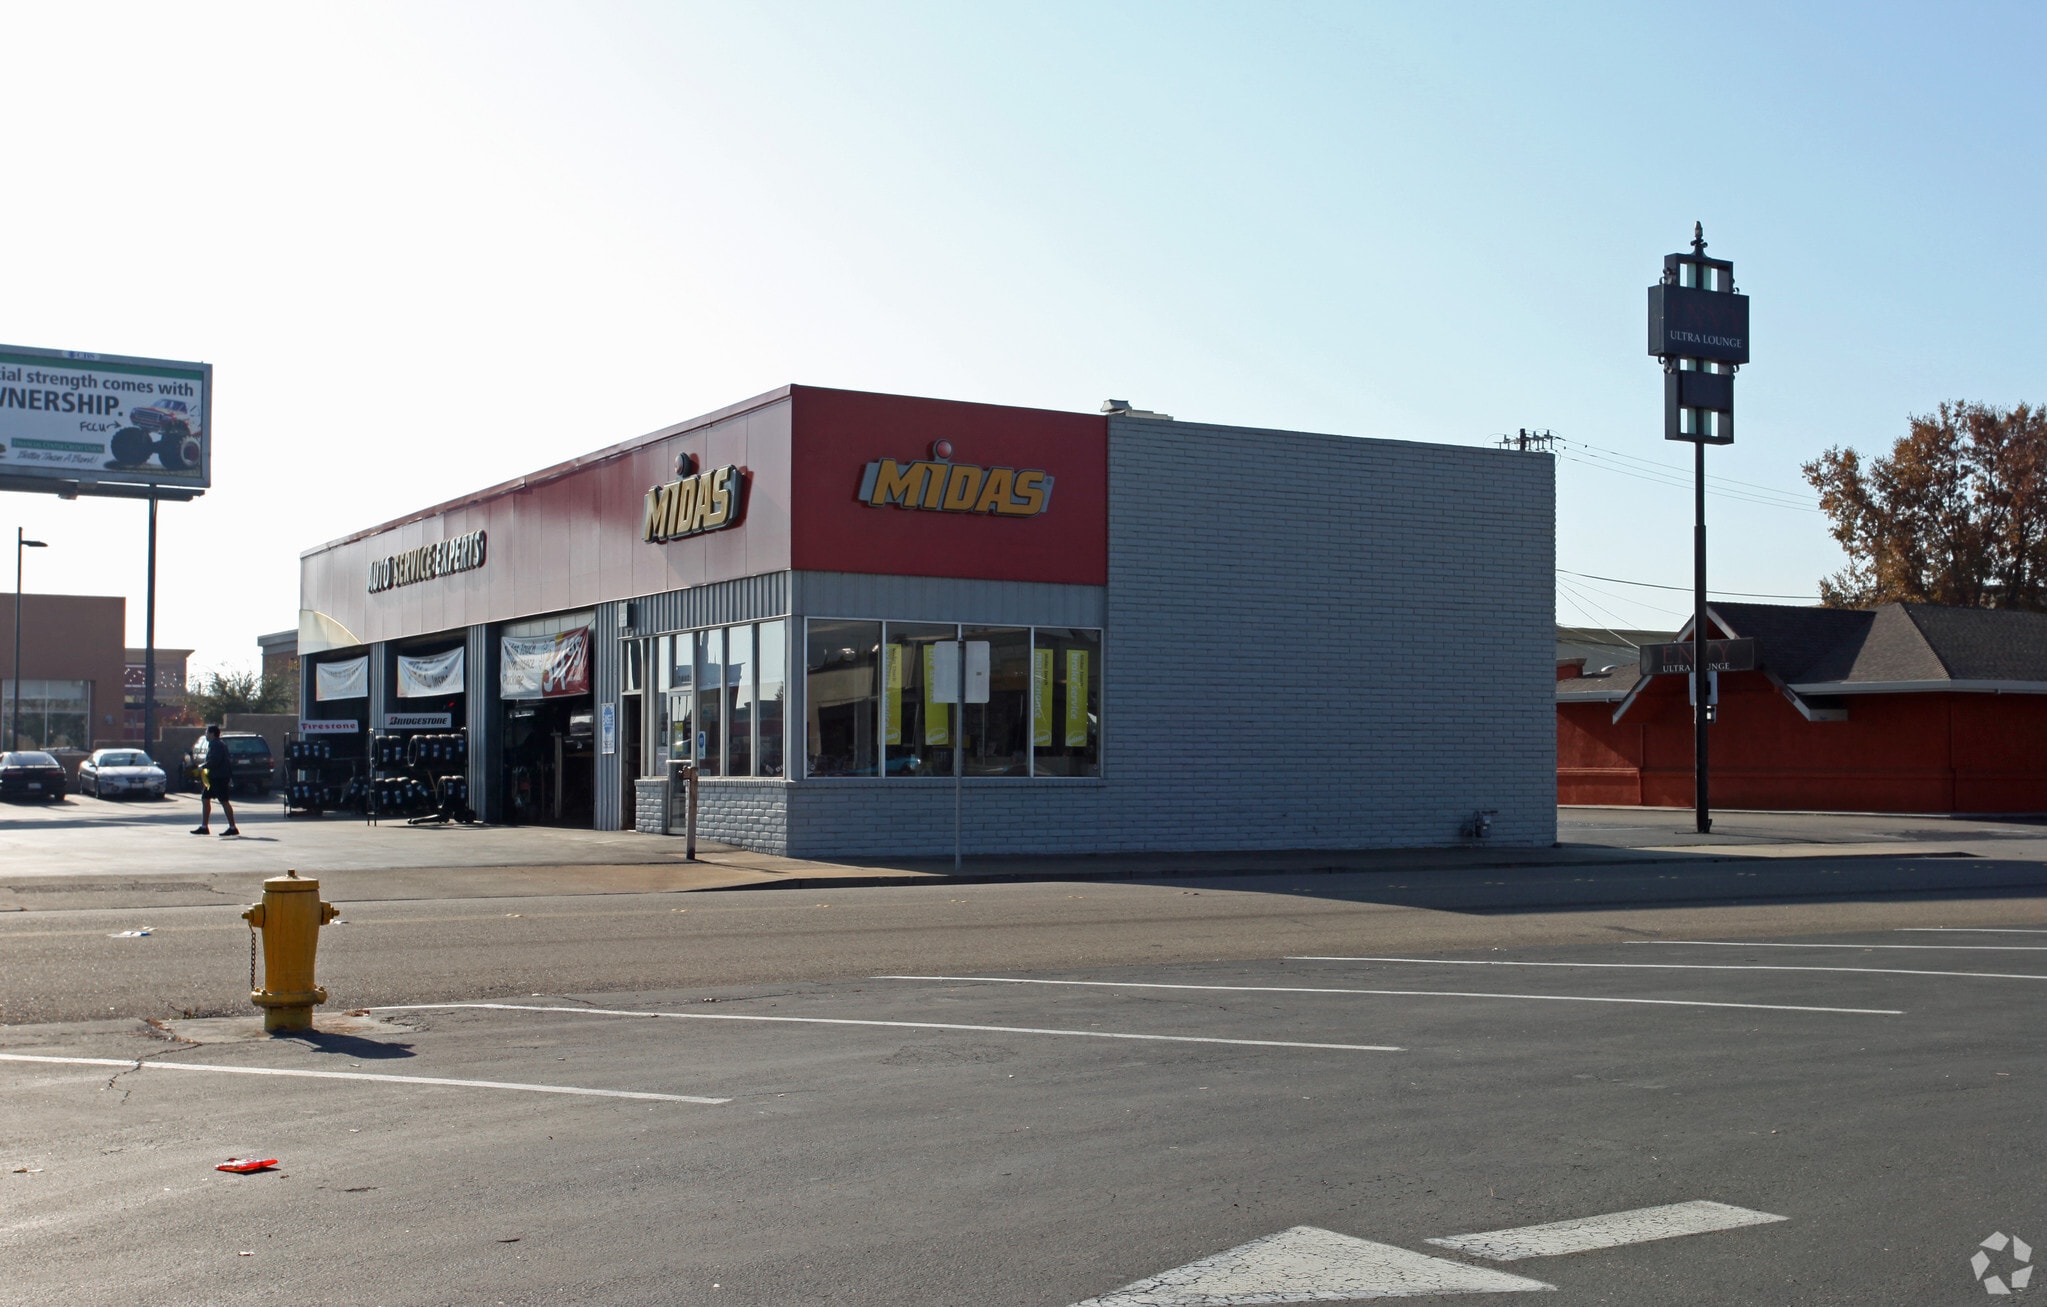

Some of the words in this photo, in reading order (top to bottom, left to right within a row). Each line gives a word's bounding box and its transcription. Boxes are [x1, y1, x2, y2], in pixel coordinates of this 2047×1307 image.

[1670, 330, 1701, 343] ULTRA
[1703, 335, 1742, 348] LOUNGE
[0, 367, 22, 382] ial
[26, 371, 98, 391] strength
[103, 379, 154, 394] comes
[158, 382, 195, 397] with
[868, 440, 1047, 517] MIDAS
[644, 453, 730, 542] MIDAS
[368, 556, 394, 593] AUTO
[394, 545, 436, 588] SERVICE
[435, 530, 486, 578] EXPERTS
[1071, 653, 1080, 682] brake
[1663, 642, 1730, 664] ENY
[1662, 664, 1691, 673] ULTRA
[1071, 685, 1079, 719] service
[301, 722, 356, 731] Firestone
[388, 716, 448, 726] BRIDGESTONE
